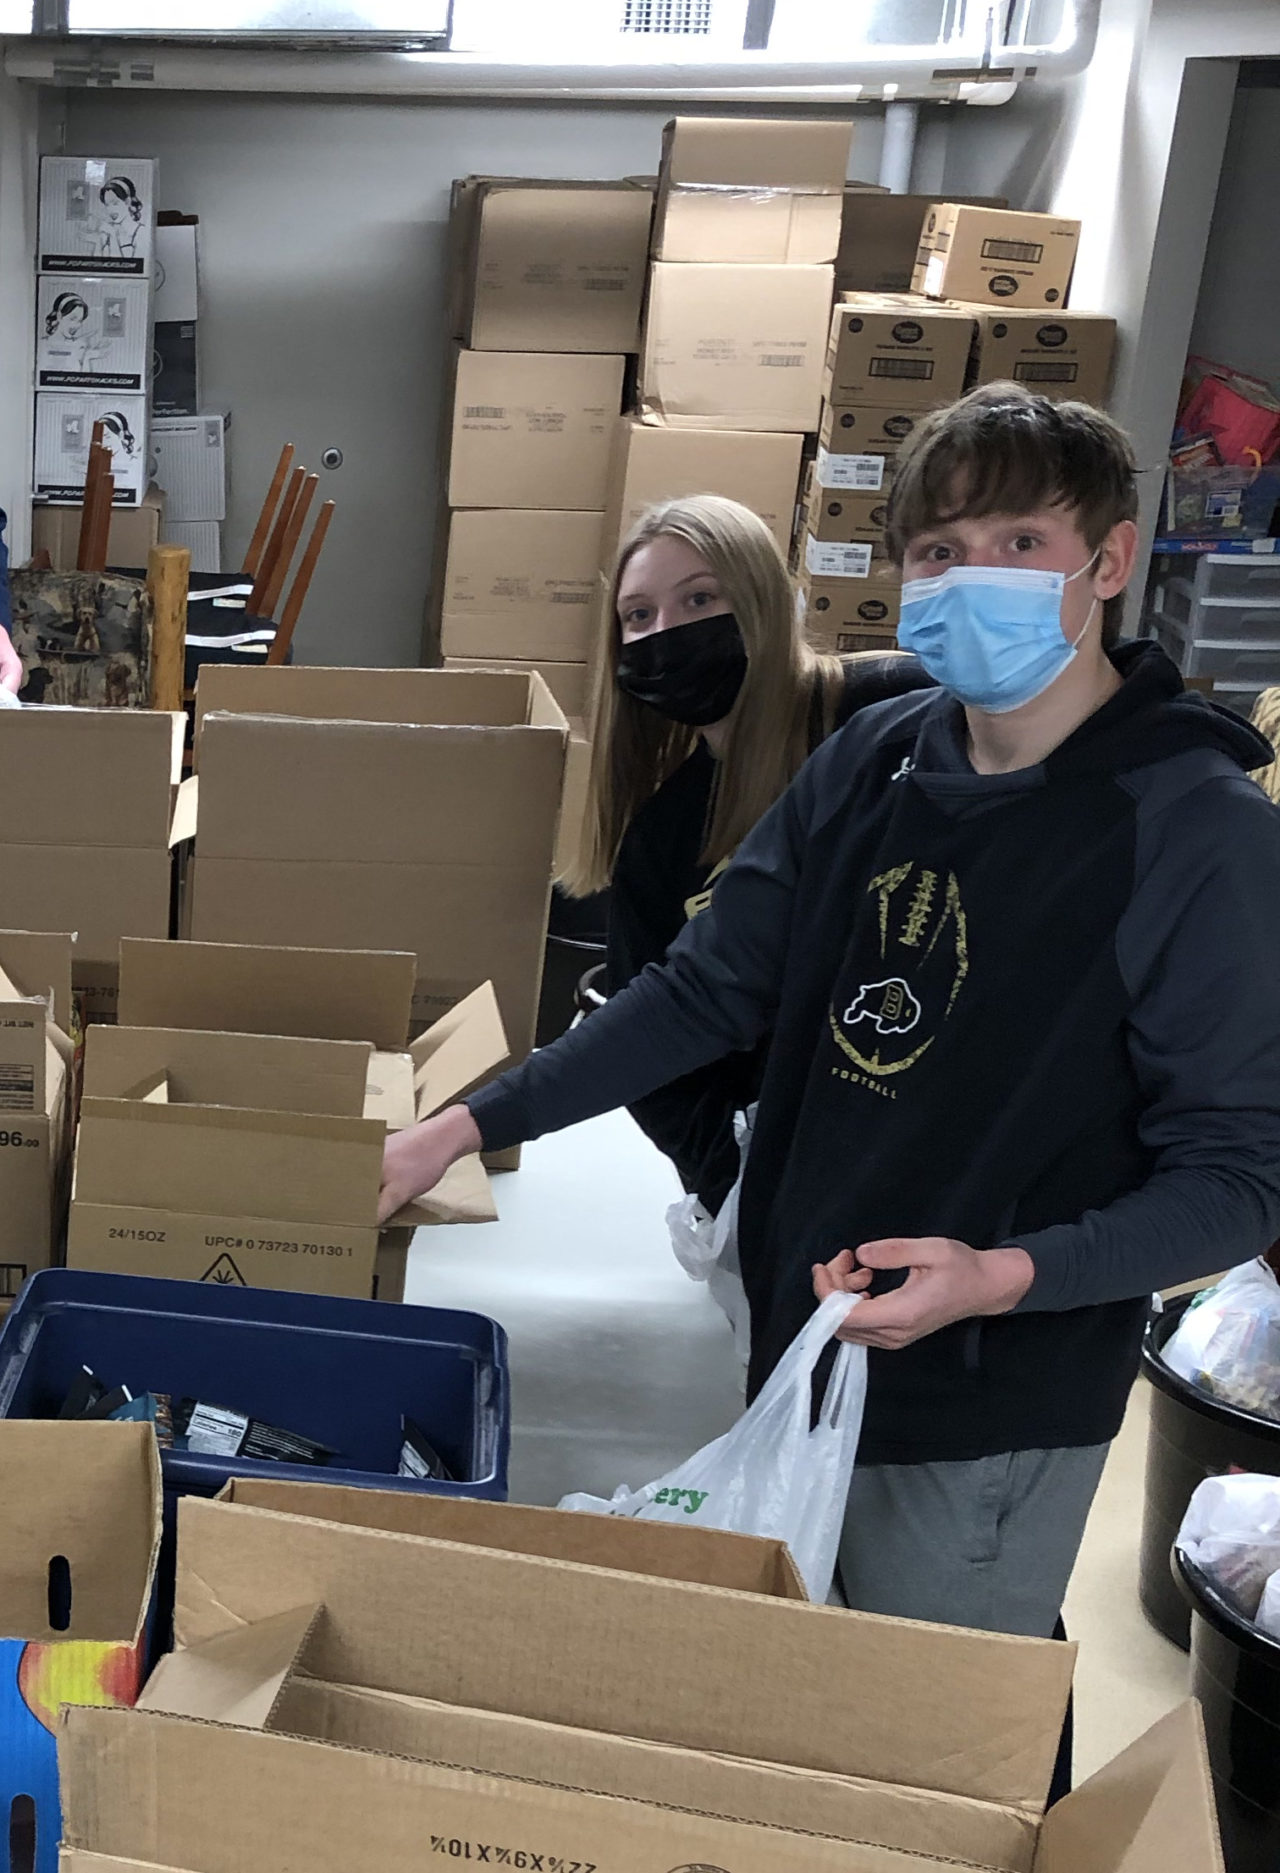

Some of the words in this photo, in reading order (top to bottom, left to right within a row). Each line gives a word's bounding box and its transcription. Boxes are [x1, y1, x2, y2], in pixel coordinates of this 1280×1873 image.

[832, 1067, 896, 1099] FOOTBALL
[205, 1236, 243, 1249] UPC#
[258, 1240, 299, 1254] 73723
[302, 1243, 343, 1257] 70130
